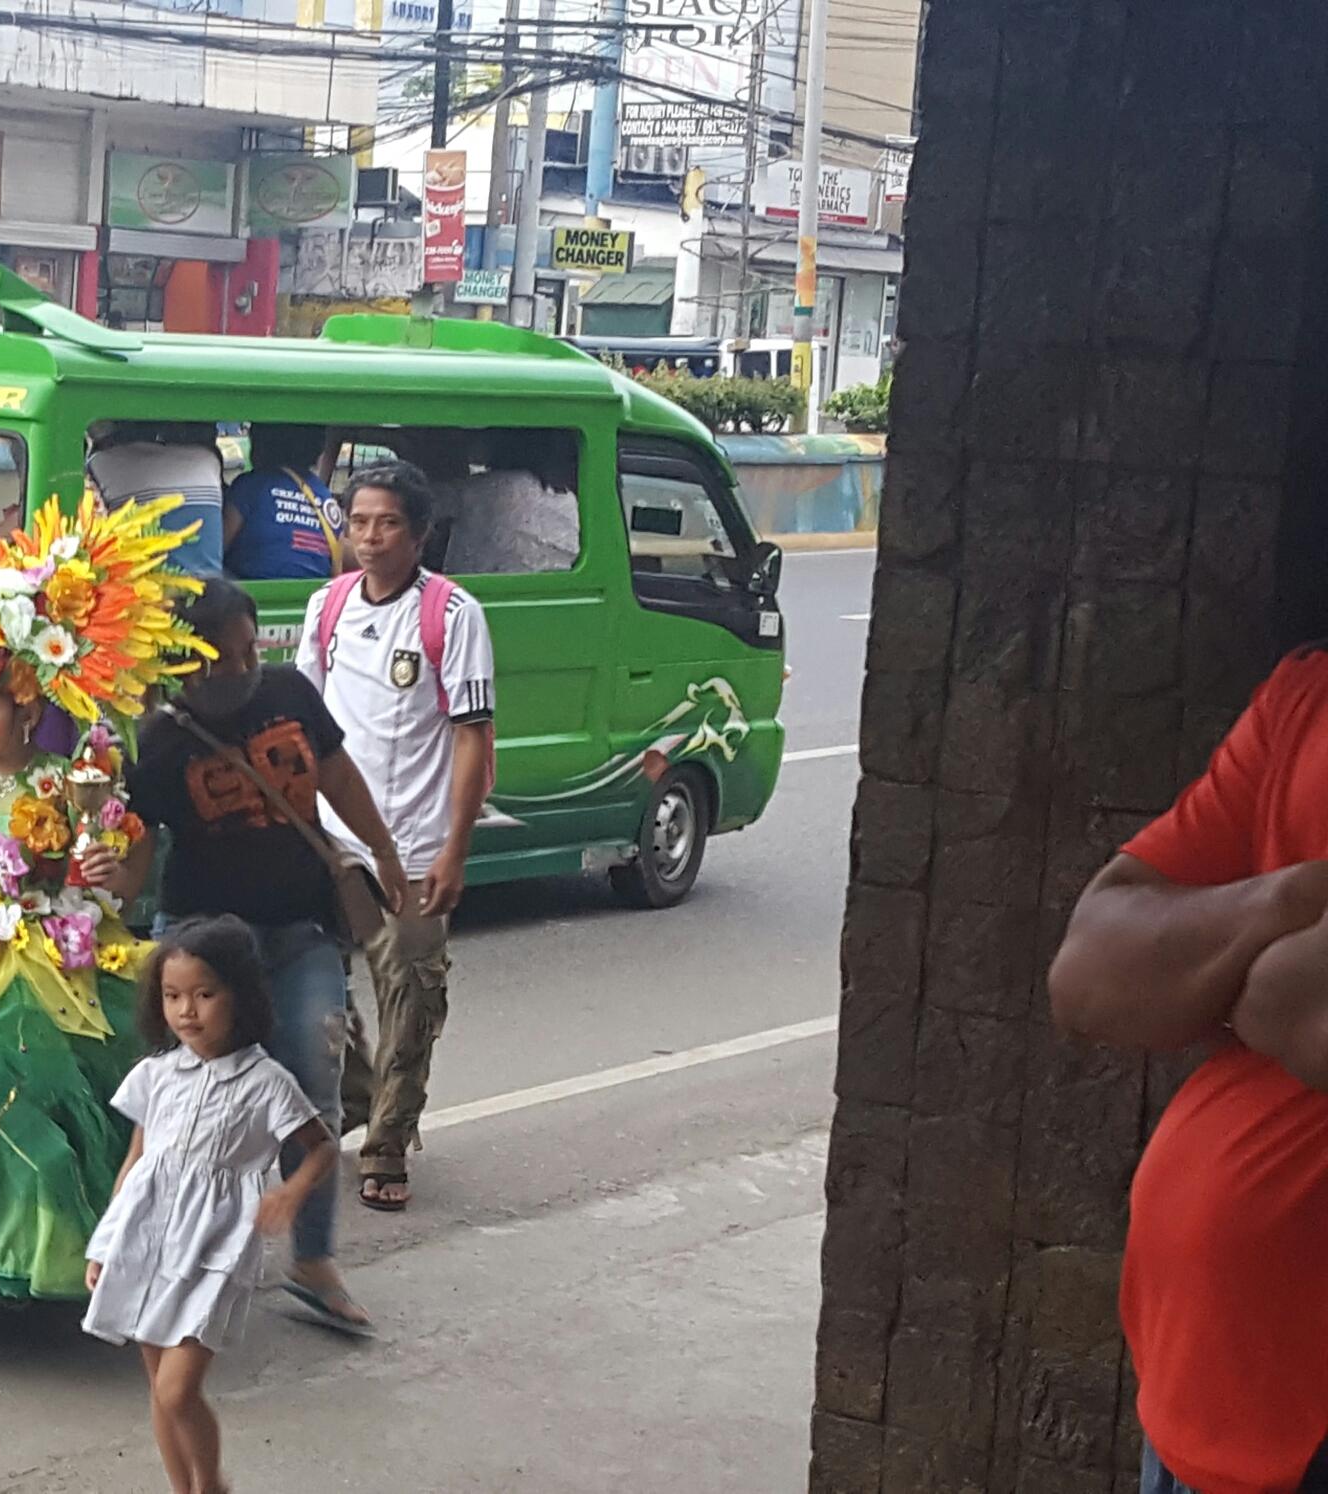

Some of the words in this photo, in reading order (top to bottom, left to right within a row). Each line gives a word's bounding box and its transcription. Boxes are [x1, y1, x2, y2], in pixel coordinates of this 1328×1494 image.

[822, 170, 839, 186] THE
[818, 184, 851, 201] NERICS
[564, 229, 620, 249] MONEY
[555, 247, 625, 267] CHANGER
[464, 271, 504, 286] MONEY
[456, 284, 508, 298] CHANGER
